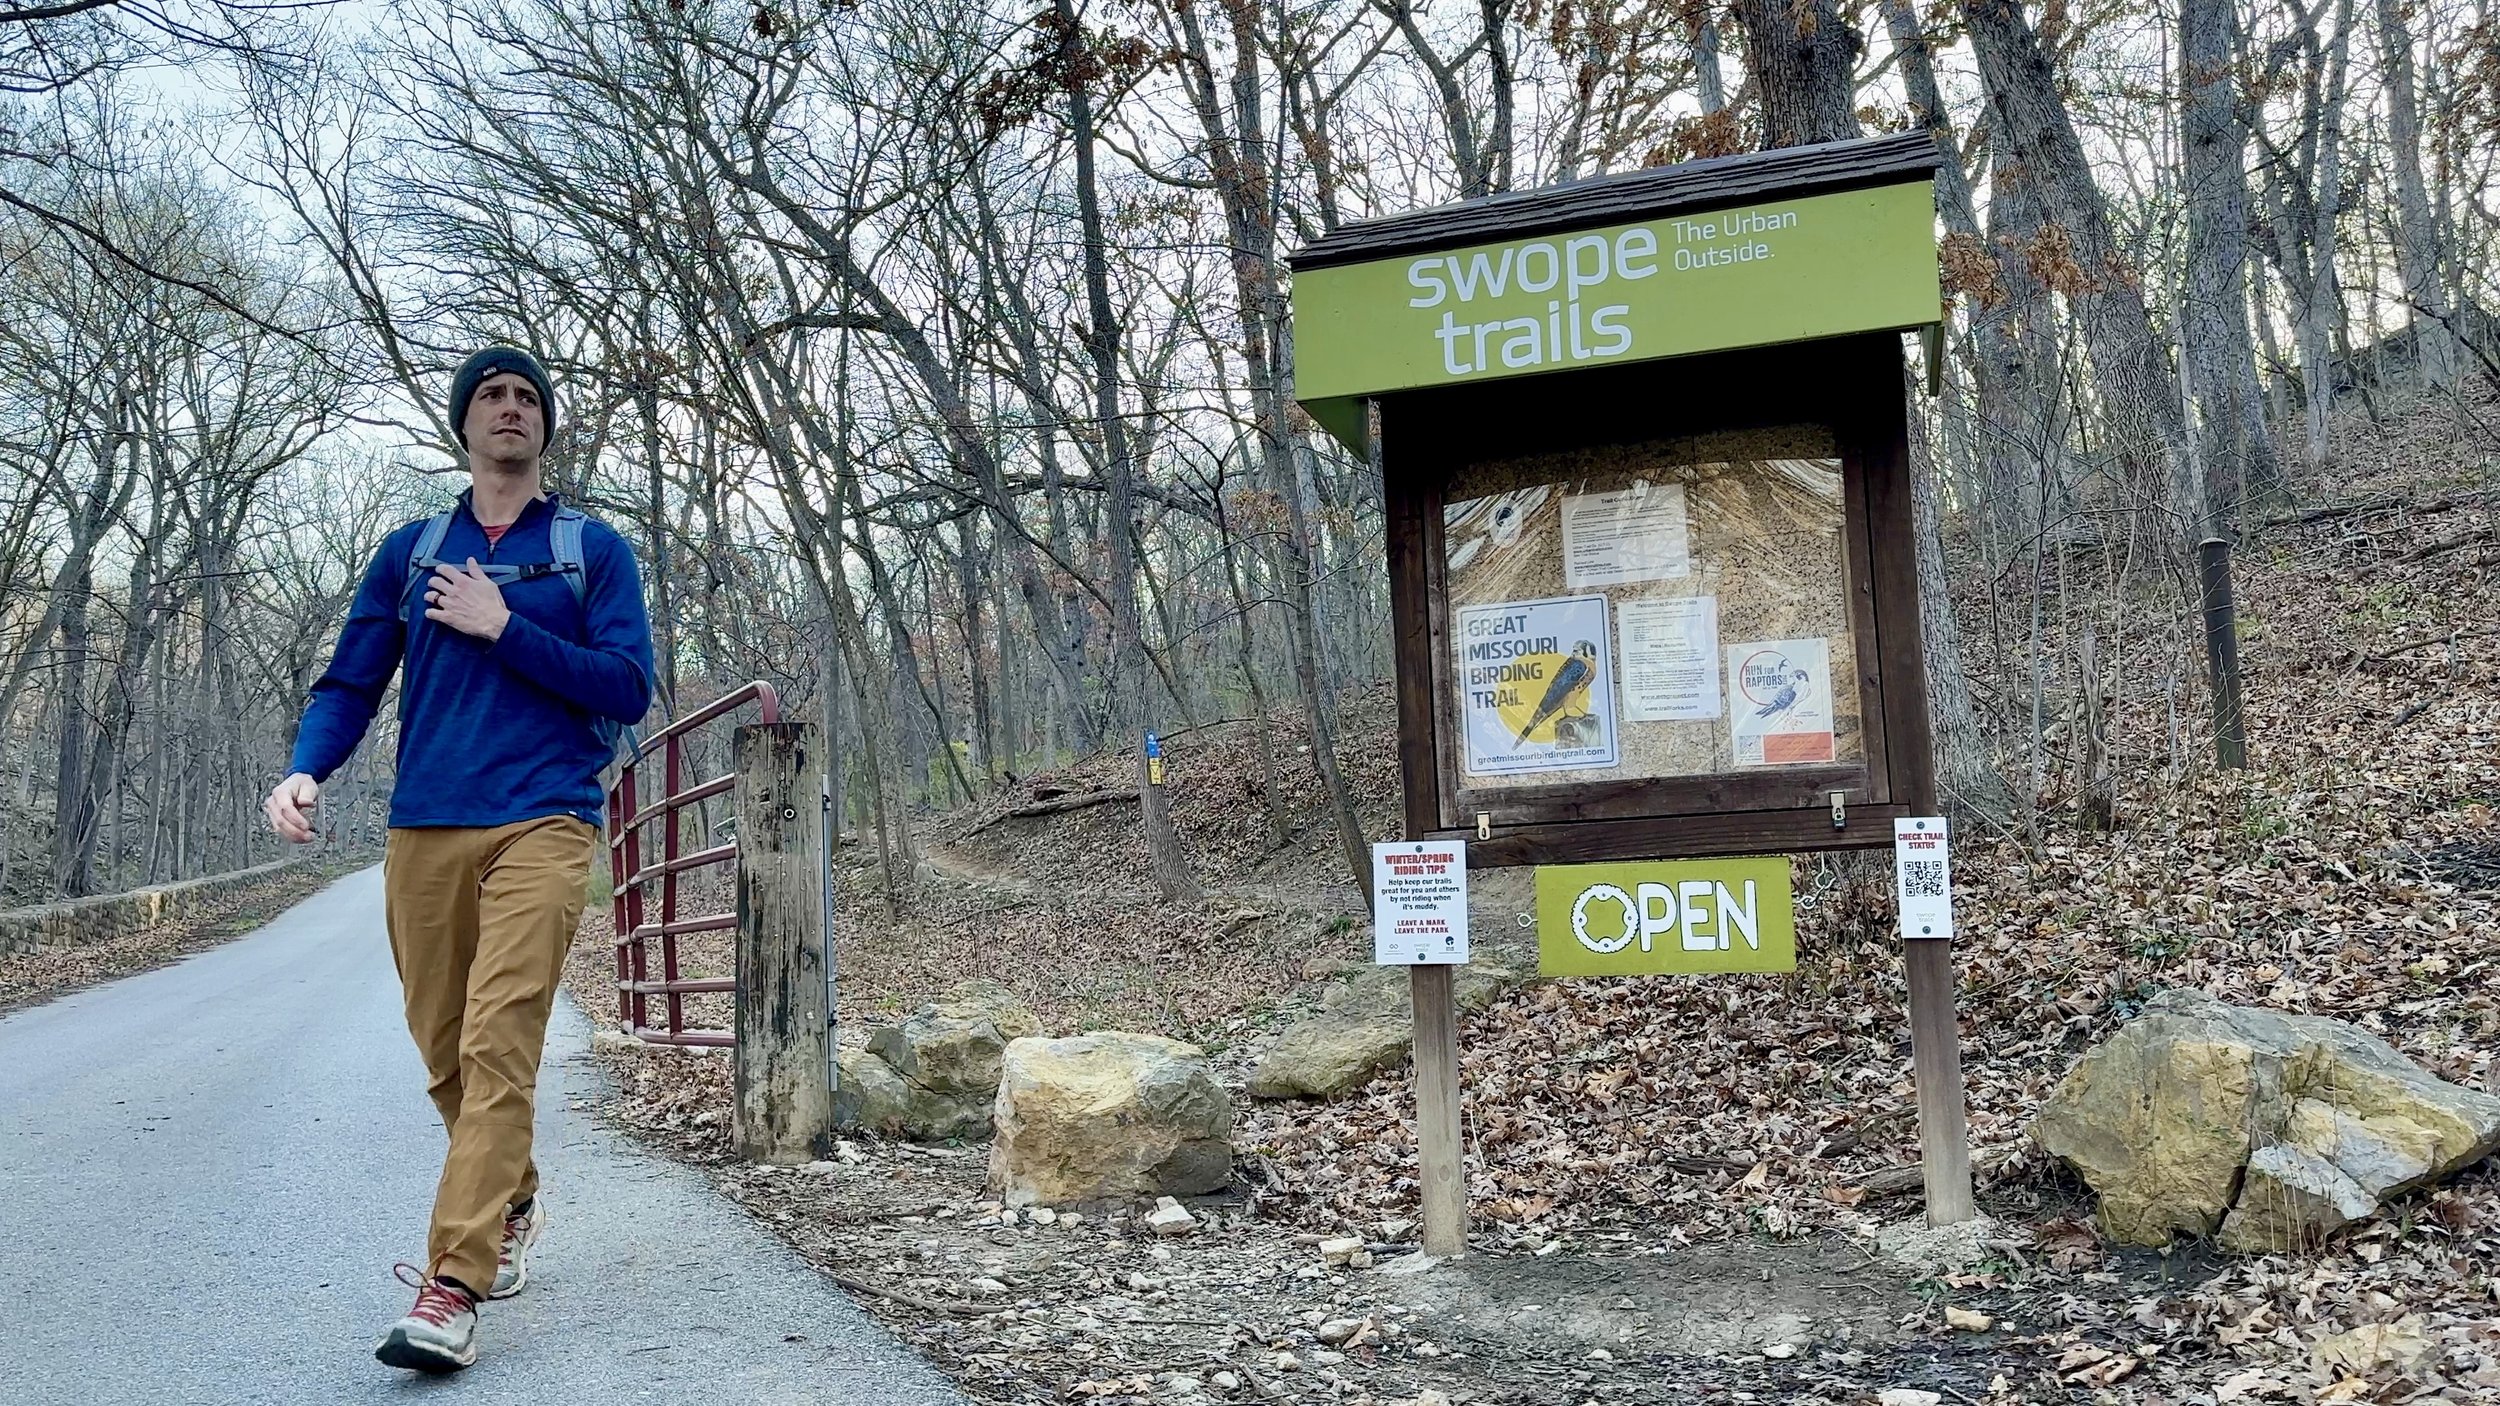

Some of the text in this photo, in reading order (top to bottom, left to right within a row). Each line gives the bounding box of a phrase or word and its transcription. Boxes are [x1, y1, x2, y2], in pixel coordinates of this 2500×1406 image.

[1671, 209, 1798, 243] The Urban
[1673, 241, 1776, 272] Outside.
[1408, 227, 1659, 309] swope
[1434, 299, 1633, 376] trails
[1468, 615, 1527, 637] GREAT
[1469, 636, 1558, 661] MISSOURI
[1470, 662, 1543, 685] BIRDING
[1745, 665, 1762, 676] RUN
[1745, 675, 1782, 687] RAPTORS
[1472, 689, 1525, 709] TRAIL
[1478, 748, 1605, 764] greatmissouribirdingtrail.com
[1898, 832, 1946, 841] CHECK TRAIL
[1908, 841, 1936, 850] STATUS
[1385, 854, 1454, 864] WINTER/SPRING
[1394, 865, 1446, 875] RIDING TIPS
[1381, 887, 1399, 895] great
[1390, 895, 1398, 903] by
[1570, 879, 1759, 953] OPEN
